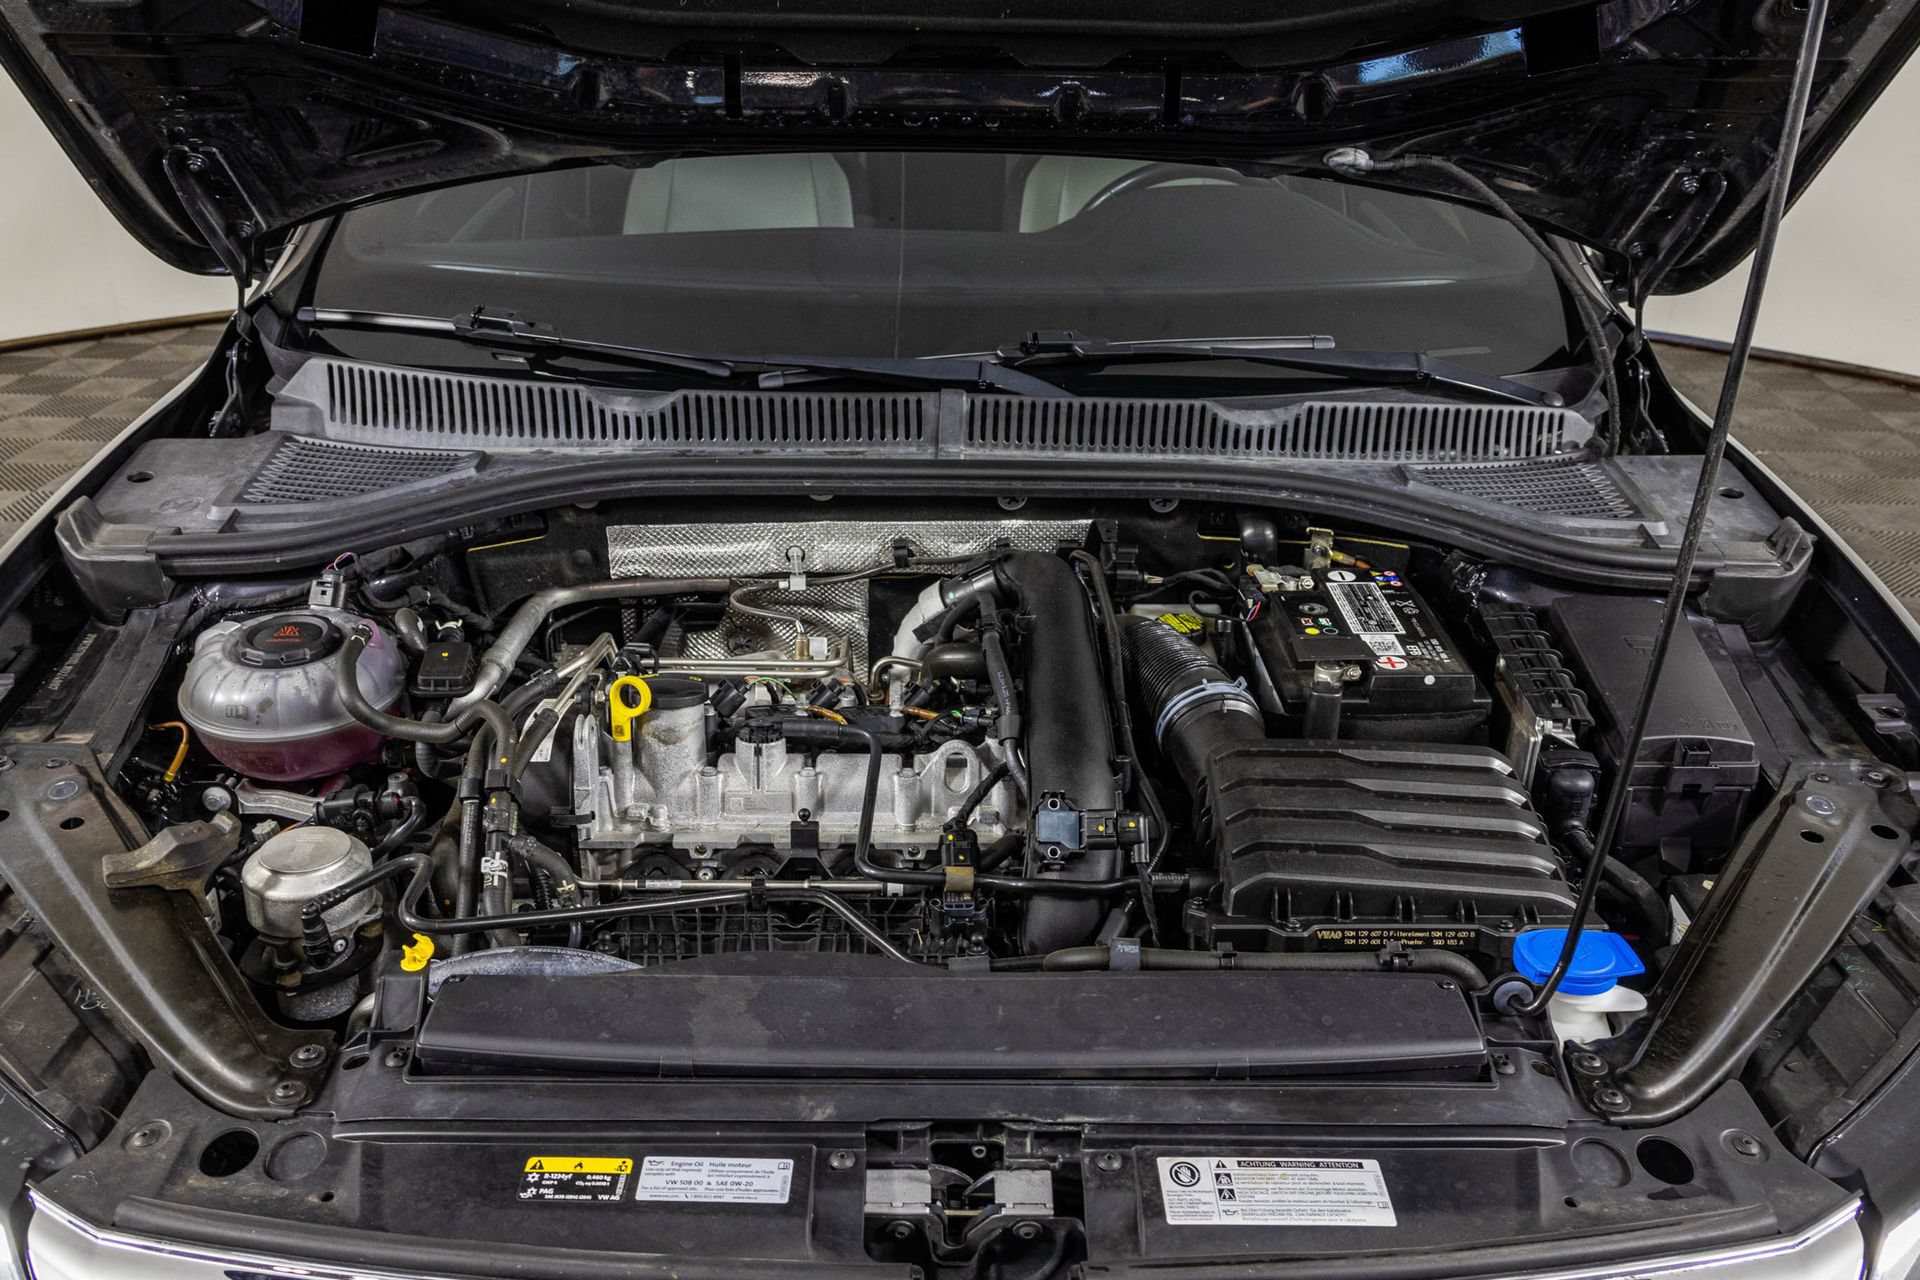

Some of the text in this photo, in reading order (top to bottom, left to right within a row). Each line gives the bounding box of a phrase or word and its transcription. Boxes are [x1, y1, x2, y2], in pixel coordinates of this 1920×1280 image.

[1459, 938, 1465, 946] A
[671, 1160, 693, 1168] Engine
[1279, 1161, 1316, 1169] WARNING
[543, 1173, 573, 1181] R-1234yf
